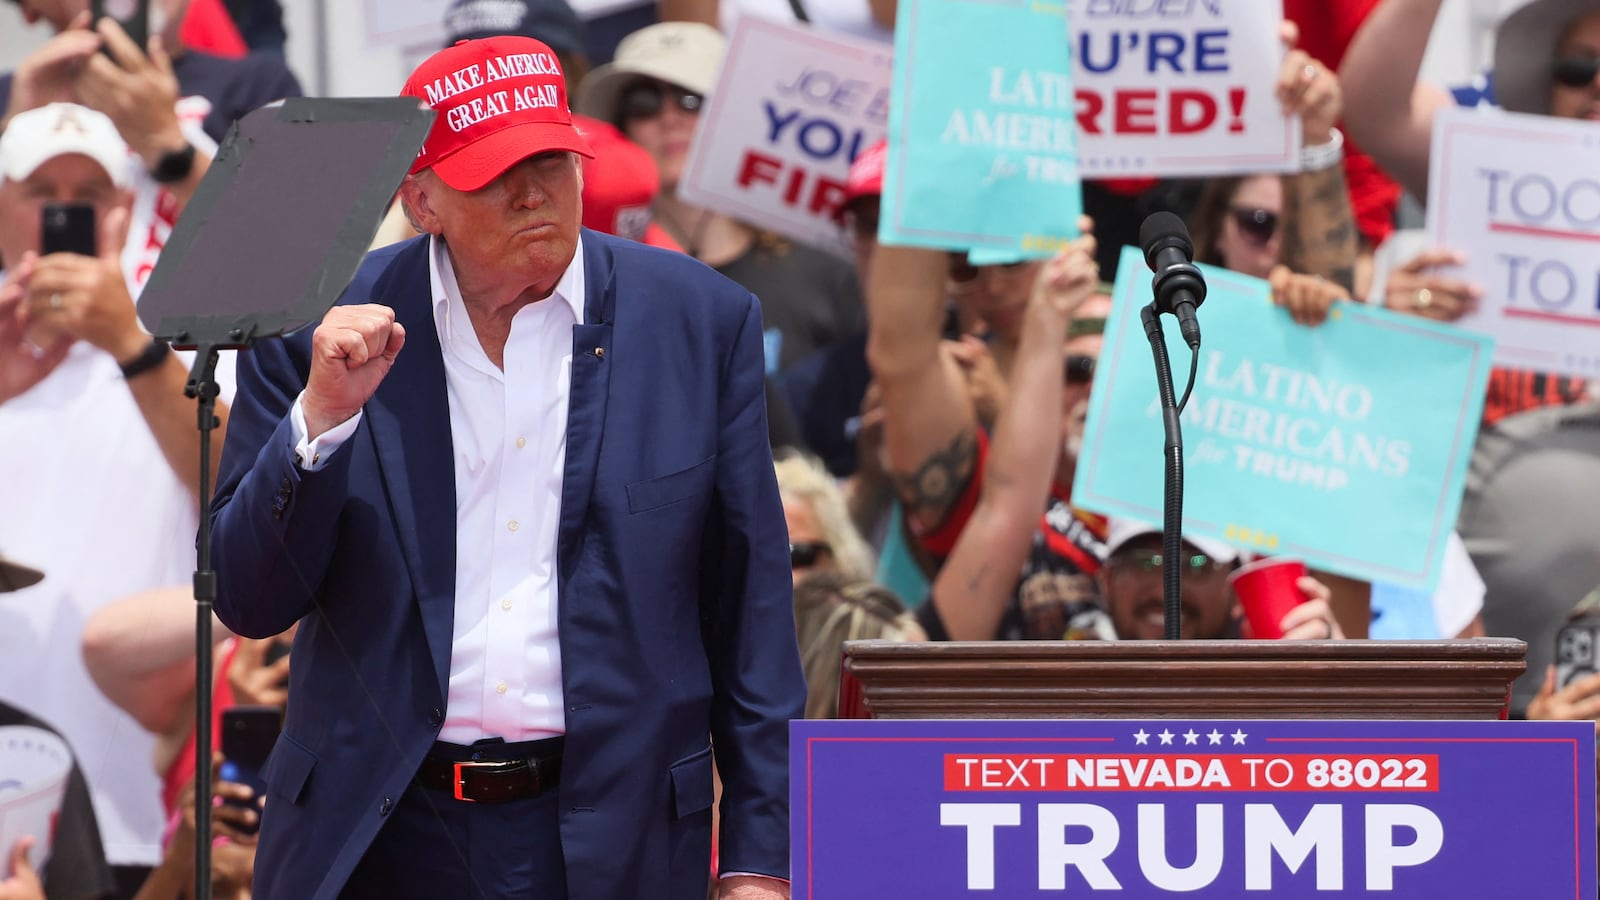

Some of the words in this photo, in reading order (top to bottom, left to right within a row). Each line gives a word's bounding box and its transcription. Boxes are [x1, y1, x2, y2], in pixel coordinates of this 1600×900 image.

[1079, 28, 1230, 74] U'RE
[424, 64, 484, 106] MAKE
[486, 53, 560, 83] AMERICA
[447, 91, 510, 133] GREAT
[514, 84, 558, 111] AGAIN
[1074, 87, 1247, 136] RED!
[1498, 254, 1576, 311] TO
[1203, 350, 1374, 420] LATINO
[1233, 444, 1350, 493] TRUMP
[956, 759, 1054, 787] TEXT
[1067, 759, 1231, 787] NEVADA
[1242, 758, 1294, 787] TO
[1306, 759, 1427, 787] 88022
[940, 803, 1444, 892] TRUMP
